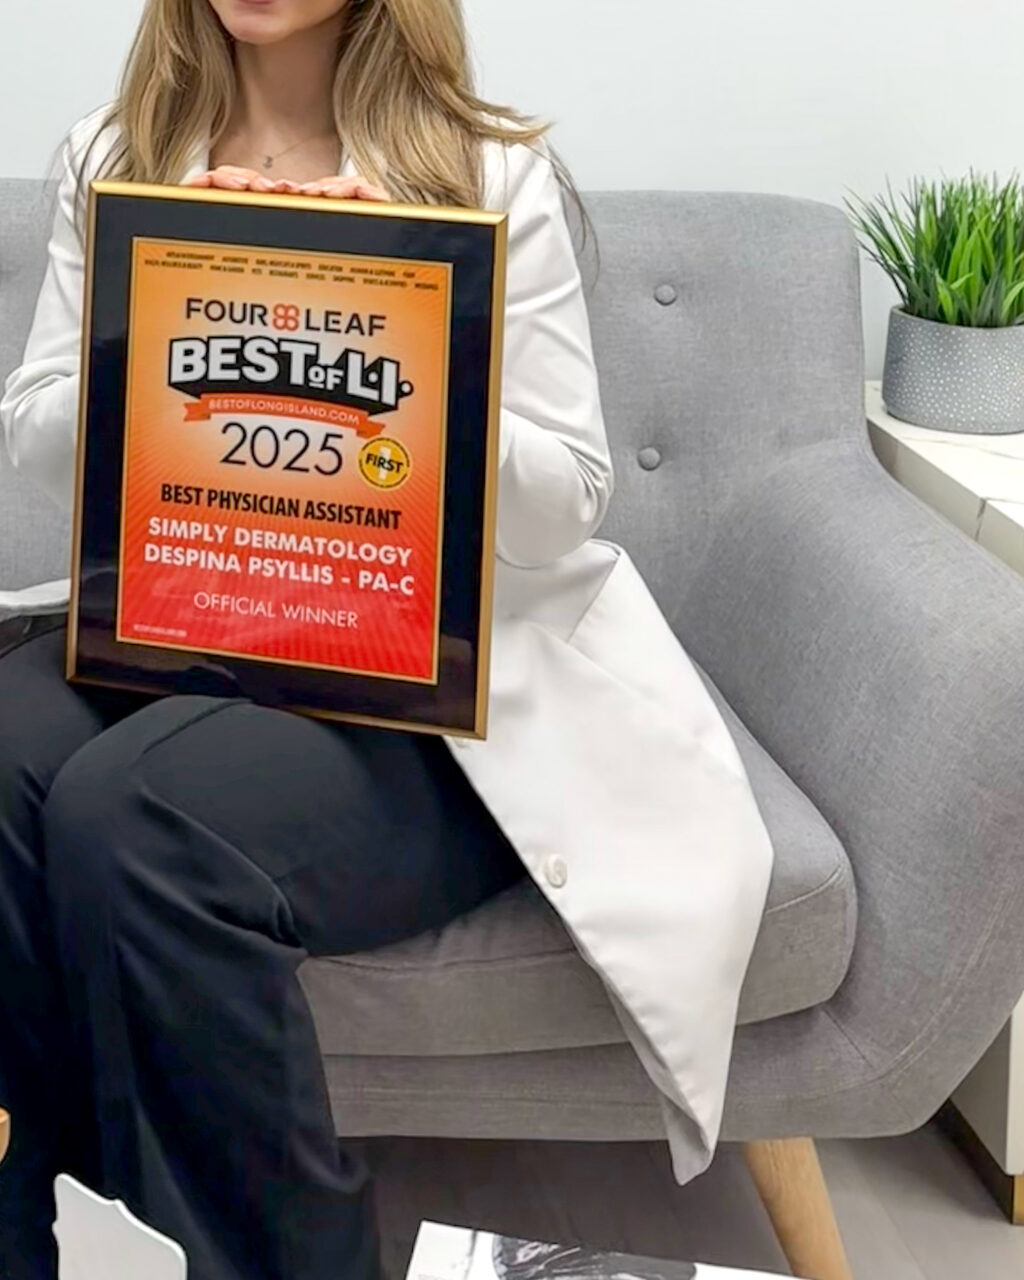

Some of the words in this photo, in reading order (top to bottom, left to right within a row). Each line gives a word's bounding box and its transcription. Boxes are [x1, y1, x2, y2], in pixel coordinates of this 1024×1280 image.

[186, 298, 268, 326] FOUR
[305, 308, 387, 336] LEAF
[169, 336, 319, 386] BEST
[307, 364, 344, 391] OF
[347, 349, 399, 407] LI
[208, 400, 360, 425] BESTOFLONGISLAND.COM
[220, 422, 344, 477] 2025
[365, 453, 404, 474] FIRST
[161, 484, 204, 505] BEST
[207, 489, 300, 518] PHYSICIAN
[304, 501, 402, 530] ASSISTANT
[148, 516, 228, 544] SIMPLY
[234, 527, 412, 568] DERMATOLOGY
[144, 543, 241, 574] DESPINA
[248, 556, 334, 586] PSYLLIS
[358, 570, 415, 596] PA-C
[193, 591, 276, 619] OFFICIAL
[281, 602, 359, 629] WINNER
